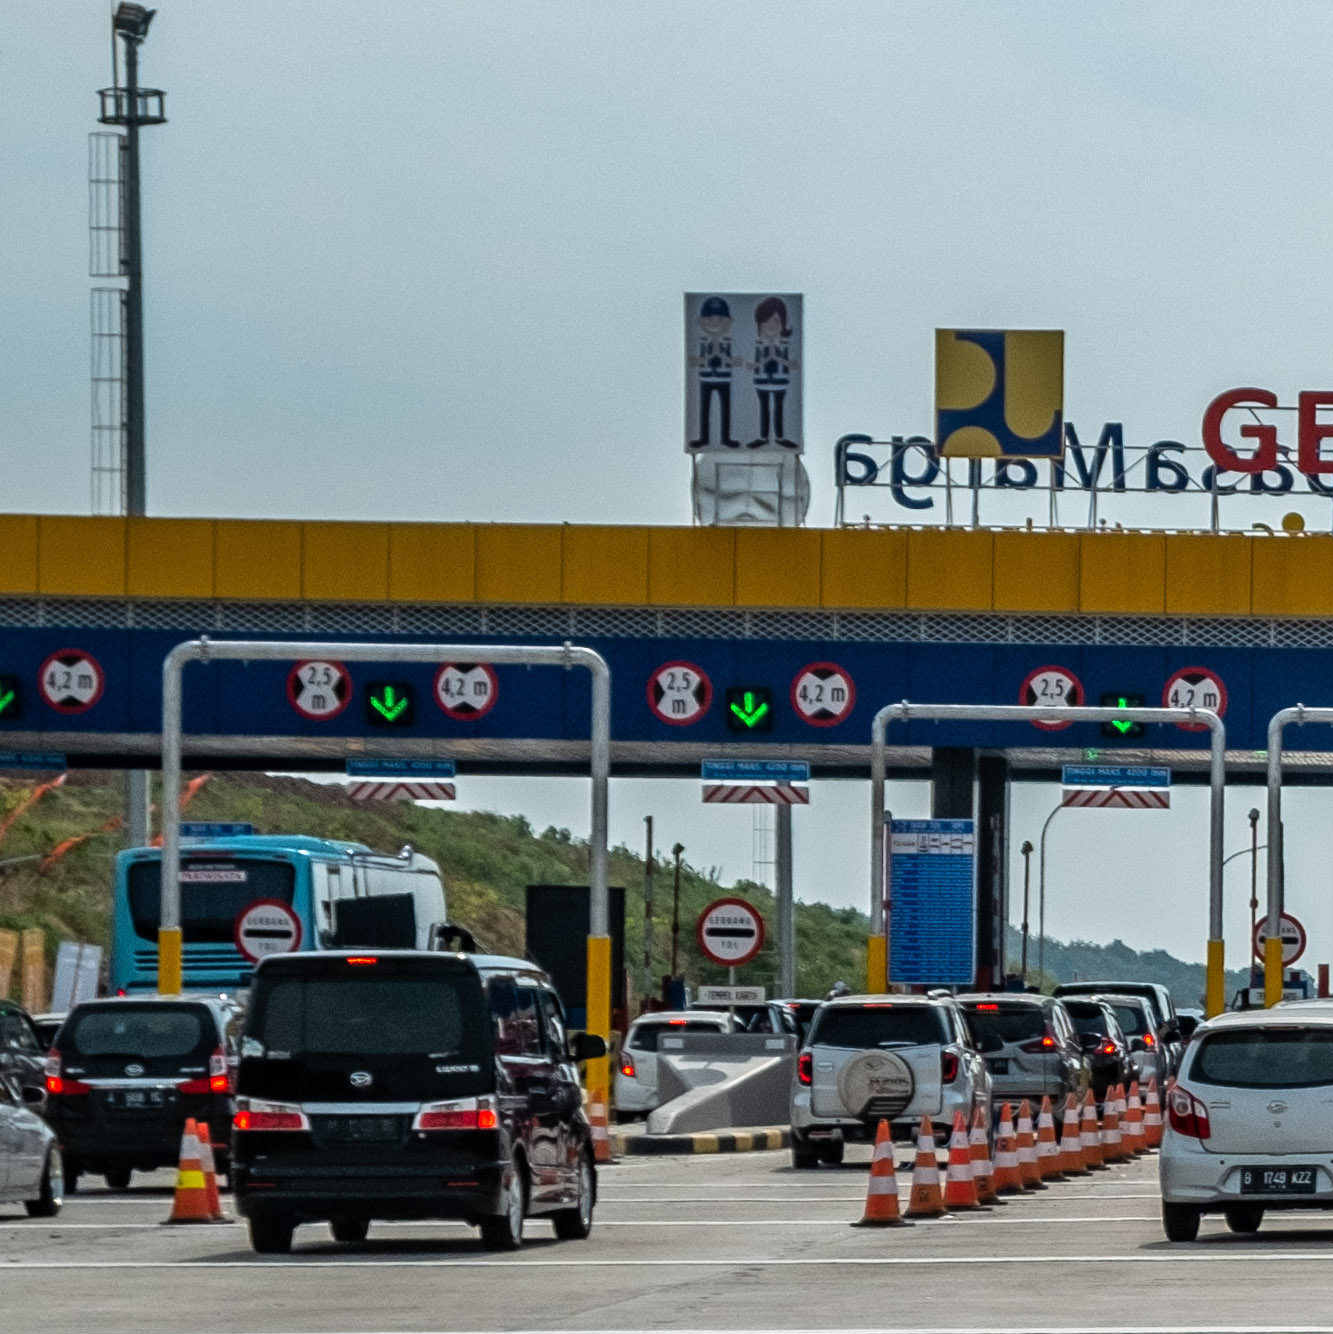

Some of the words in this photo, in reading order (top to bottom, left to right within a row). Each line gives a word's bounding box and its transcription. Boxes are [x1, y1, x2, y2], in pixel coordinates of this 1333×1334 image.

[307, 666, 331, 687] 2,5
[667, 672, 691, 692] 2,5
[442, 677, 465, 698] 4,2
[473, 680, 488, 696] m
[800, 684, 824, 705] 4,2
[831, 687, 846, 703] m
[1041, 678, 1064, 699] 2,5
[311, 694, 326, 710] m
[672, 699, 686, 714] m
[1171, 688, 1195, 708] 4,2
[1203, 692, 1217, 707] m
